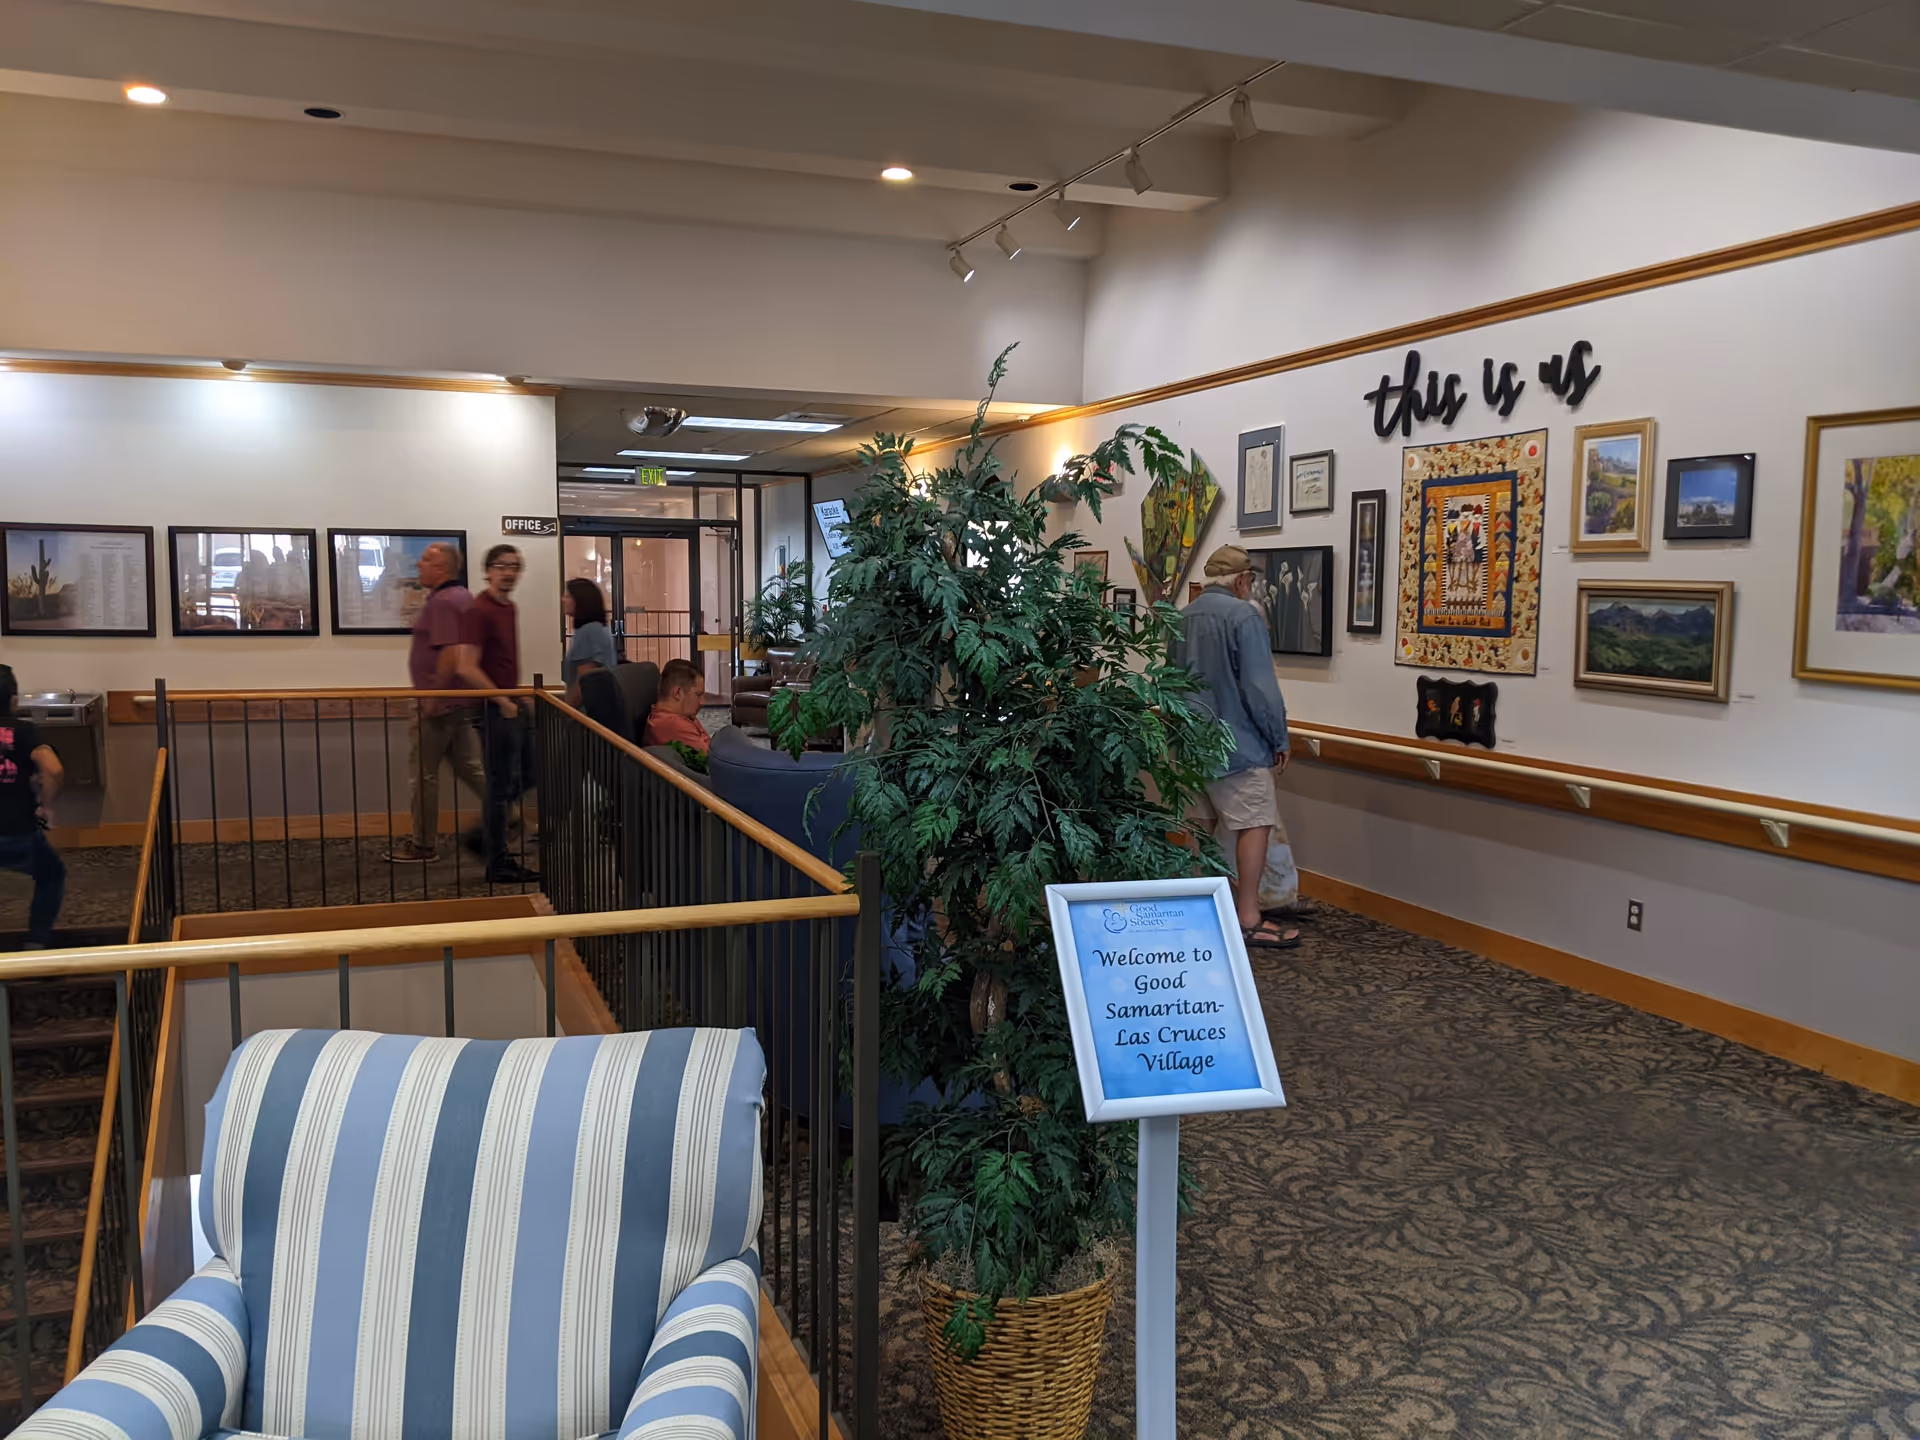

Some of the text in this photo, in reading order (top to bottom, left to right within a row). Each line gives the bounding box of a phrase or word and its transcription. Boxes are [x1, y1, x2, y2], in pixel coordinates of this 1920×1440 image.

[1363, 340, 1602, 437] this is us
[641, 468, 664, 485] EXIT
[820, 504, 840, 517] Karaoke
[505, 519, 541, 530] OFFICE
[1129, 904, 1158, 913] Good
[1136, 910, 1185, 920] Samaritan
[1129, 918, 1165, 927] Society
[1092, 947, 1212, 967] Welcome to
[1134, 971, 1188, 995] Good
[1106, 999, 1225, 1020] Samaritan-
[1114, 1026, 1226, 1046] Las Cruces
[1137, 1051, 1215, 1075] Village
